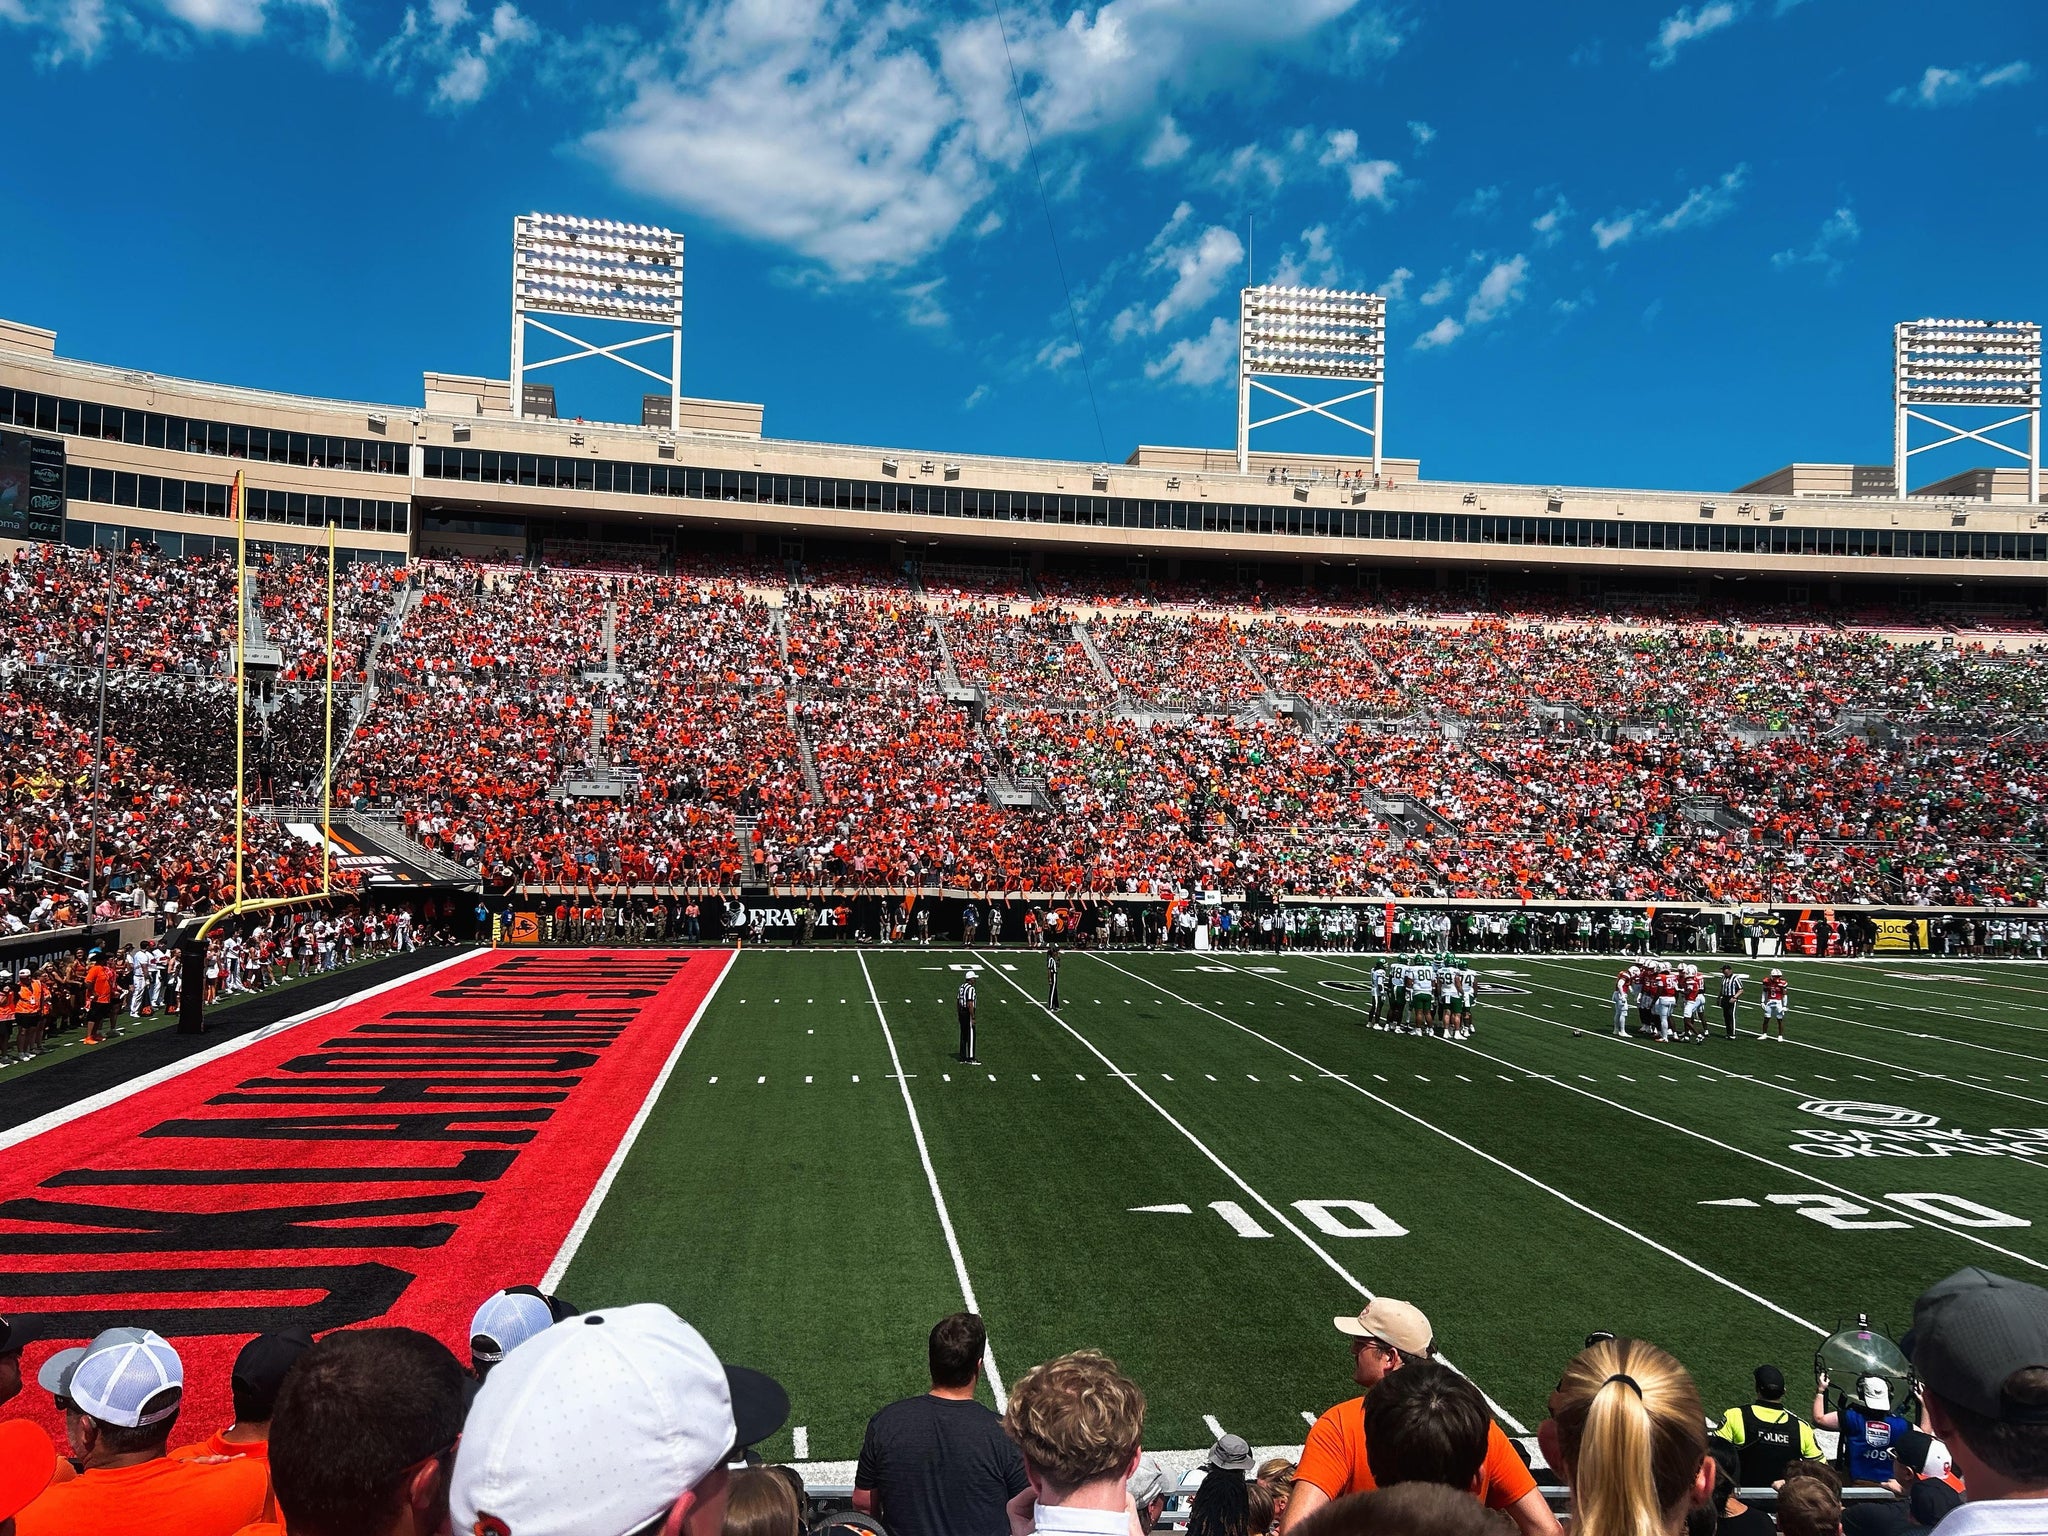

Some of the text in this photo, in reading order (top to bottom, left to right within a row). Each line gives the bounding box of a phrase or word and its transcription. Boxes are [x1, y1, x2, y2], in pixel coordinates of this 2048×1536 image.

[32, 447, 62, 457] NISSAN
[492, 913, 501, 941] ARMY
[1417, 969, 1432, 982] 80
[1440, 972, 1453, 985] 59
[1790, 1129, 2003, 1142] BANK
[1764, 1192, 2032, 1230] 20
[1208, 1200, 1410, 1238] 10
